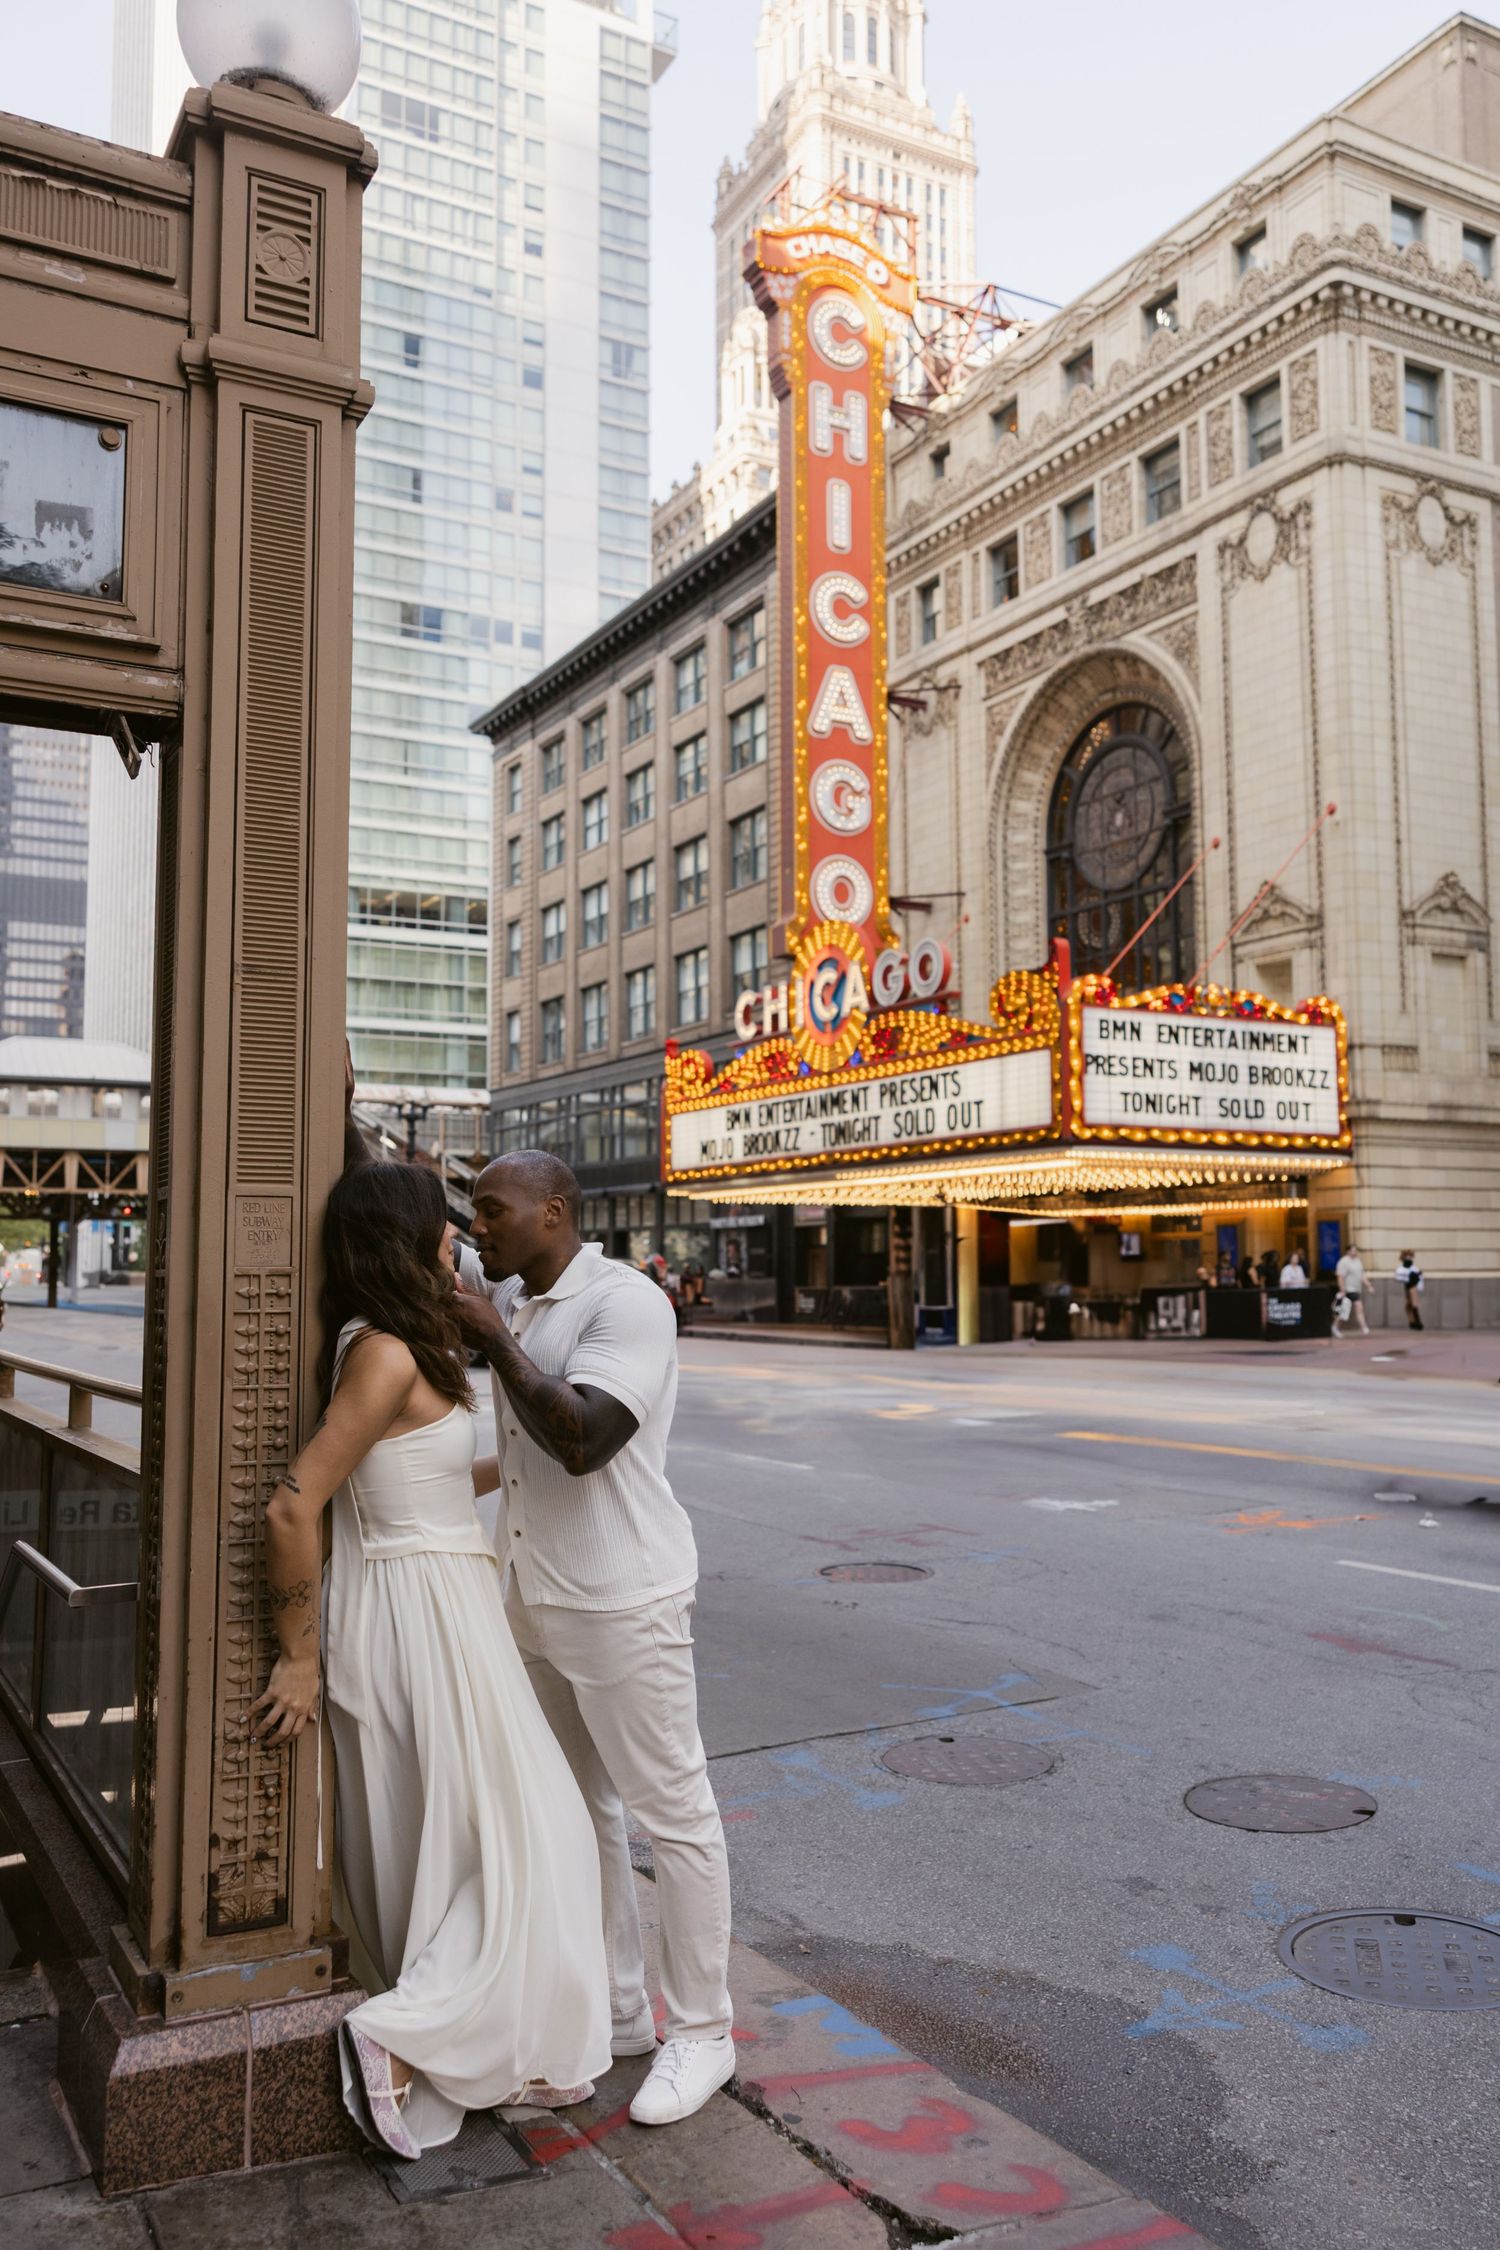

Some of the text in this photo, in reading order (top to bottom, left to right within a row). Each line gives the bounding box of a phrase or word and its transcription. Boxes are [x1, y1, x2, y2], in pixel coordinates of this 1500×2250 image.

[806, 292, 874, 928] CHICAGO
[734, 937, 951, 1041] CHICAGO
[1099, 1019, 1311, 1055] BMN ENTERTAINMENT
[1083, 1053, 1331, 1090] PRESENTS MOJO BROOKZZ
[726, 1070, 961, 1132] BMN ENTERTAINMENT PRESENTS
[1120, 1092, 1312, 1122] TONIGHT SOLD OUT
[700, 1137, 734, 1162] MOJO
[743, 1127, 800, 1157] BROOKZZ
[821, 1115, 881, 1148] TONIGHT
[893, 1108, 935, 1138] SOLD
[947, 1100, 984, 1130] OUT
[242, 1202, 287, 1214] RED LINE
[243, 1216, 283, 1227] SUBWAY
[247, 1230, 280, 1241] ENTRY
